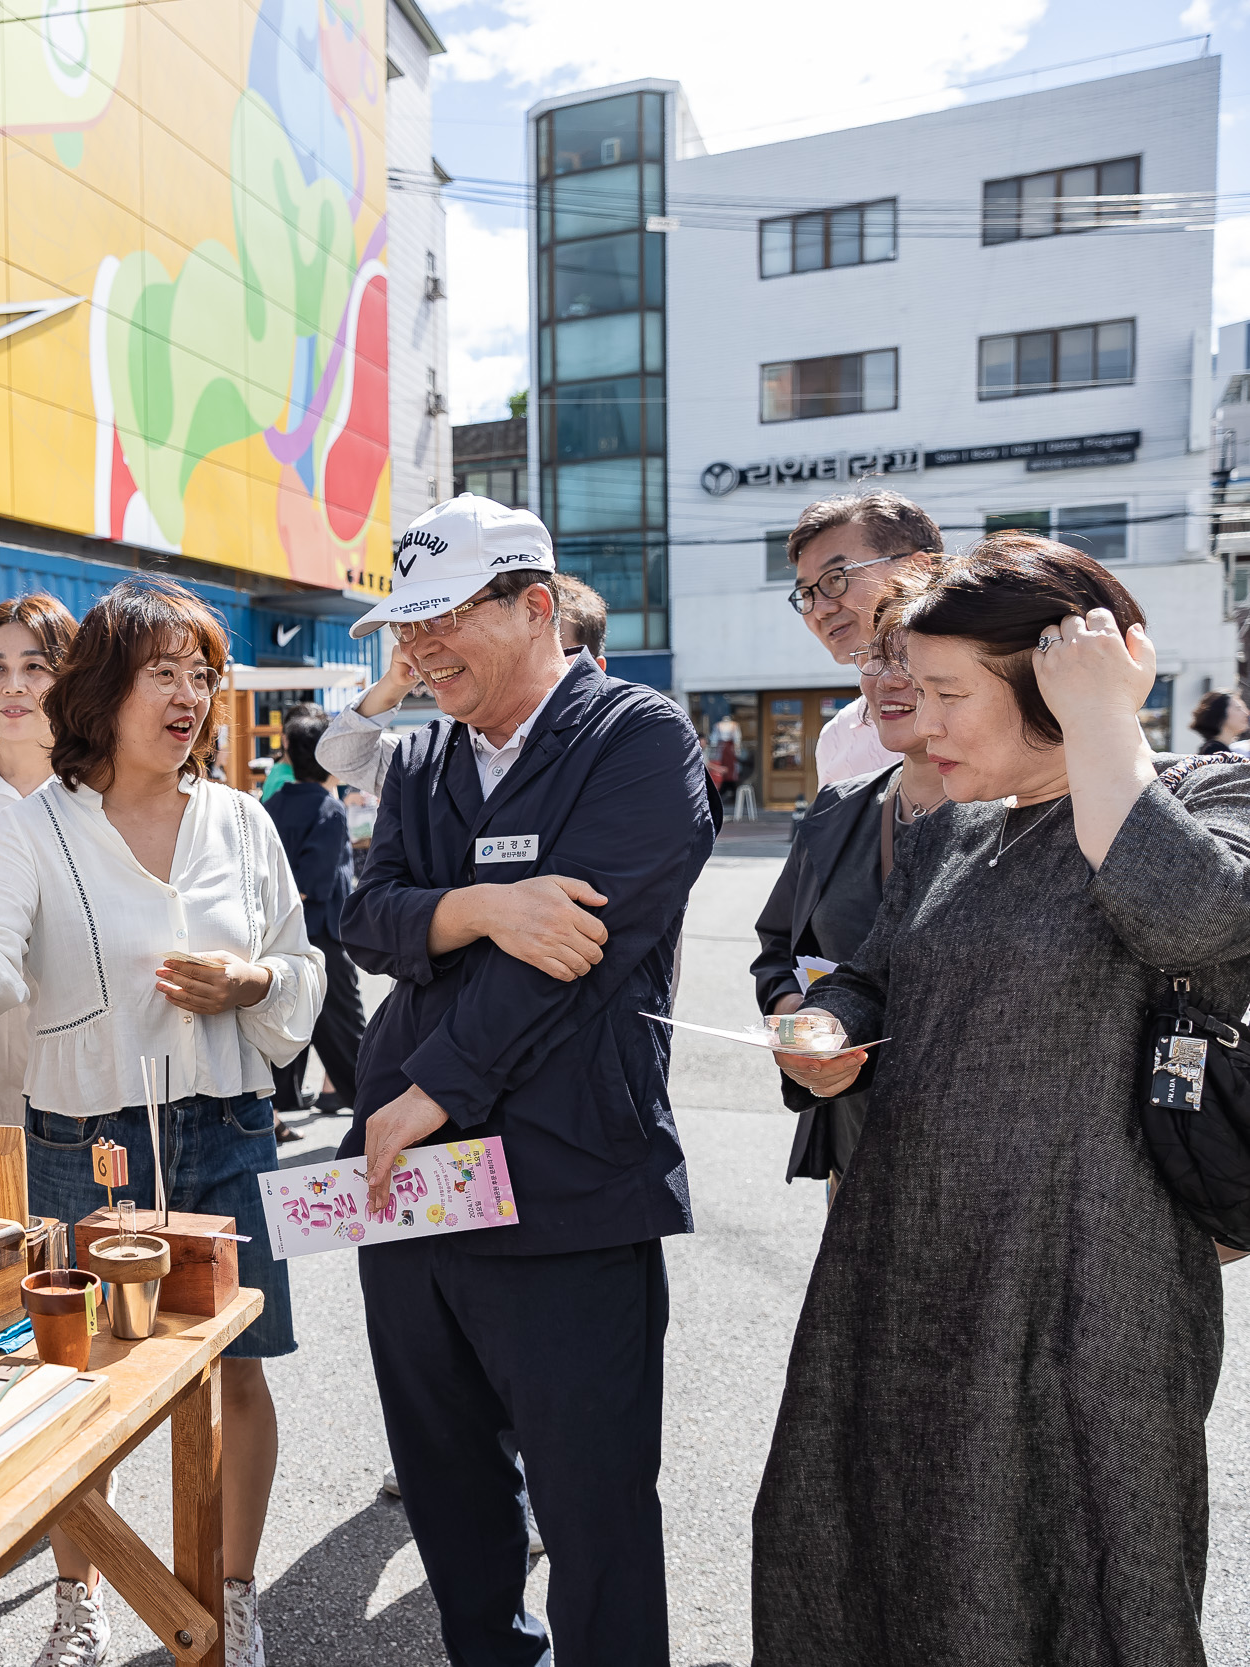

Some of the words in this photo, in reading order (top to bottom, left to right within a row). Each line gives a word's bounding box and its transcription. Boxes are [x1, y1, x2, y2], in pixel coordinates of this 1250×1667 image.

[490, 553, 542, 567] APEX
[390, 596, 451, 613] CHROME
[402, 603, 440, 615] SOFT
[1167, 1078, 1177, 1103] PRADA
[472, 1150, 482, 1167] 토요일
[282, 1192, 358, 1230] 신나는
[464, 1188, 476, 1219] 2024.11.1.
[474, 1200, 485, 1218] 금요일
